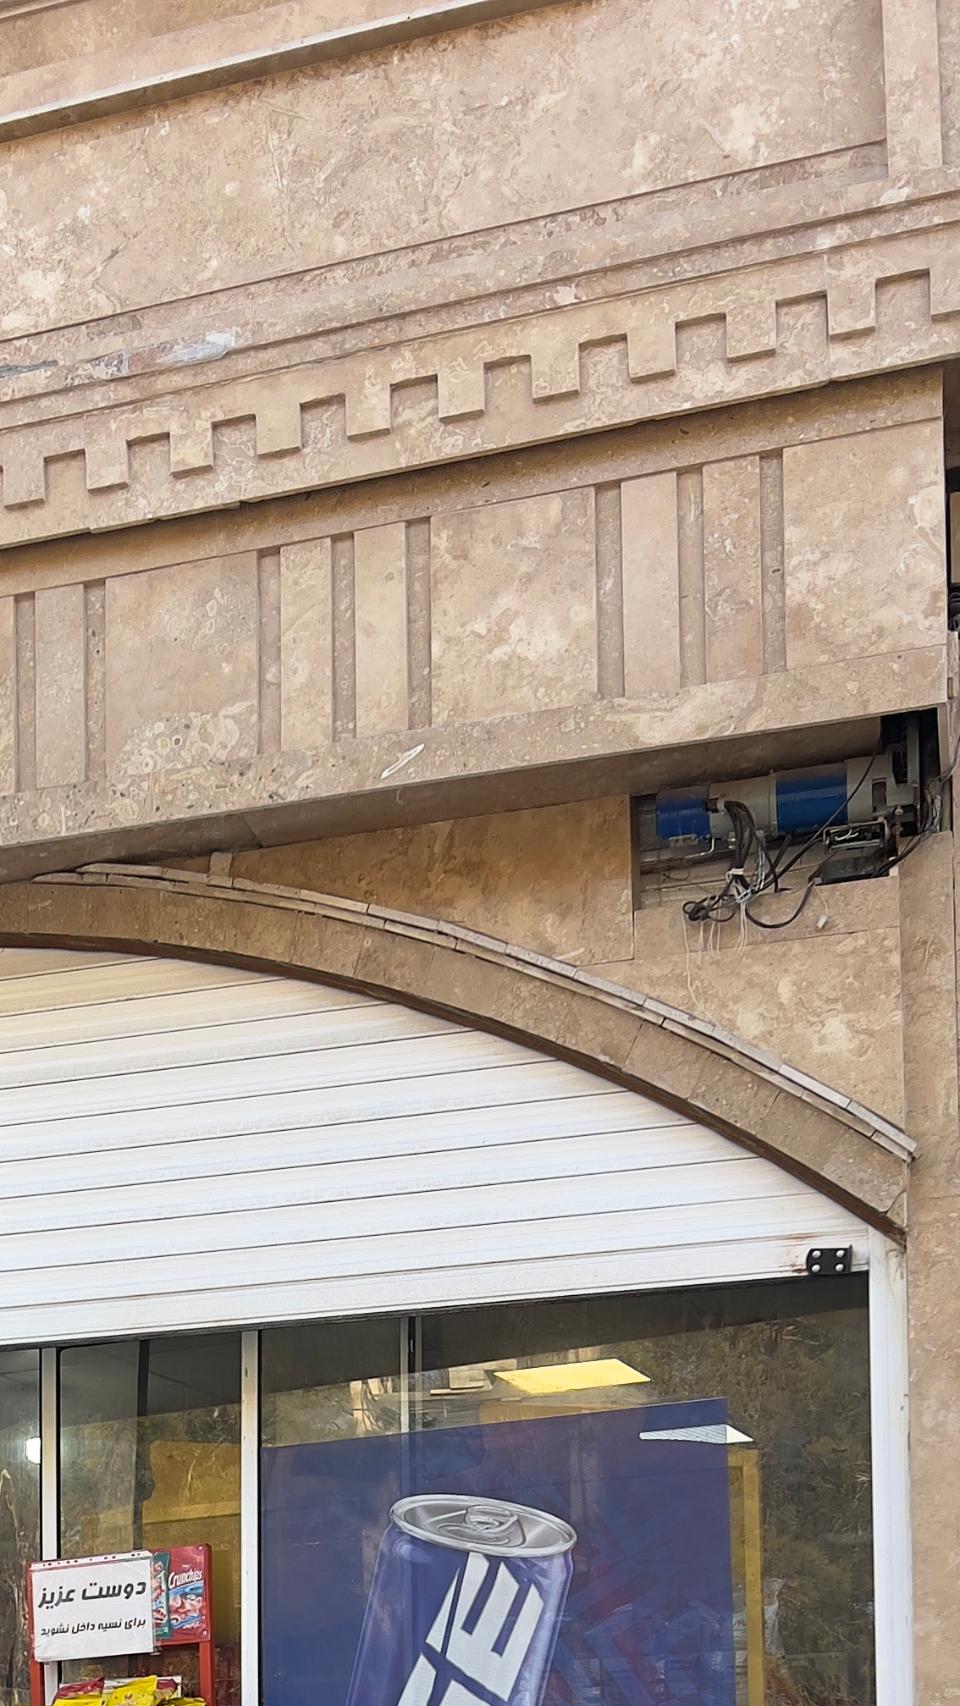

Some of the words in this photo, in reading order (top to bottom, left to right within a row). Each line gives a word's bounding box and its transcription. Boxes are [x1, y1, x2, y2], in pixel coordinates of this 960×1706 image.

[38, 1585, 75, 1609] عزیز
[81, 1581, 146, 1600] دوست
[41, 1623, 69, 1637] نشوید
[72, 1622, 95, 1635] داخل
[97, 1618, 123, 1632] نسیه
[125, 1617, 146, 1630] برای
